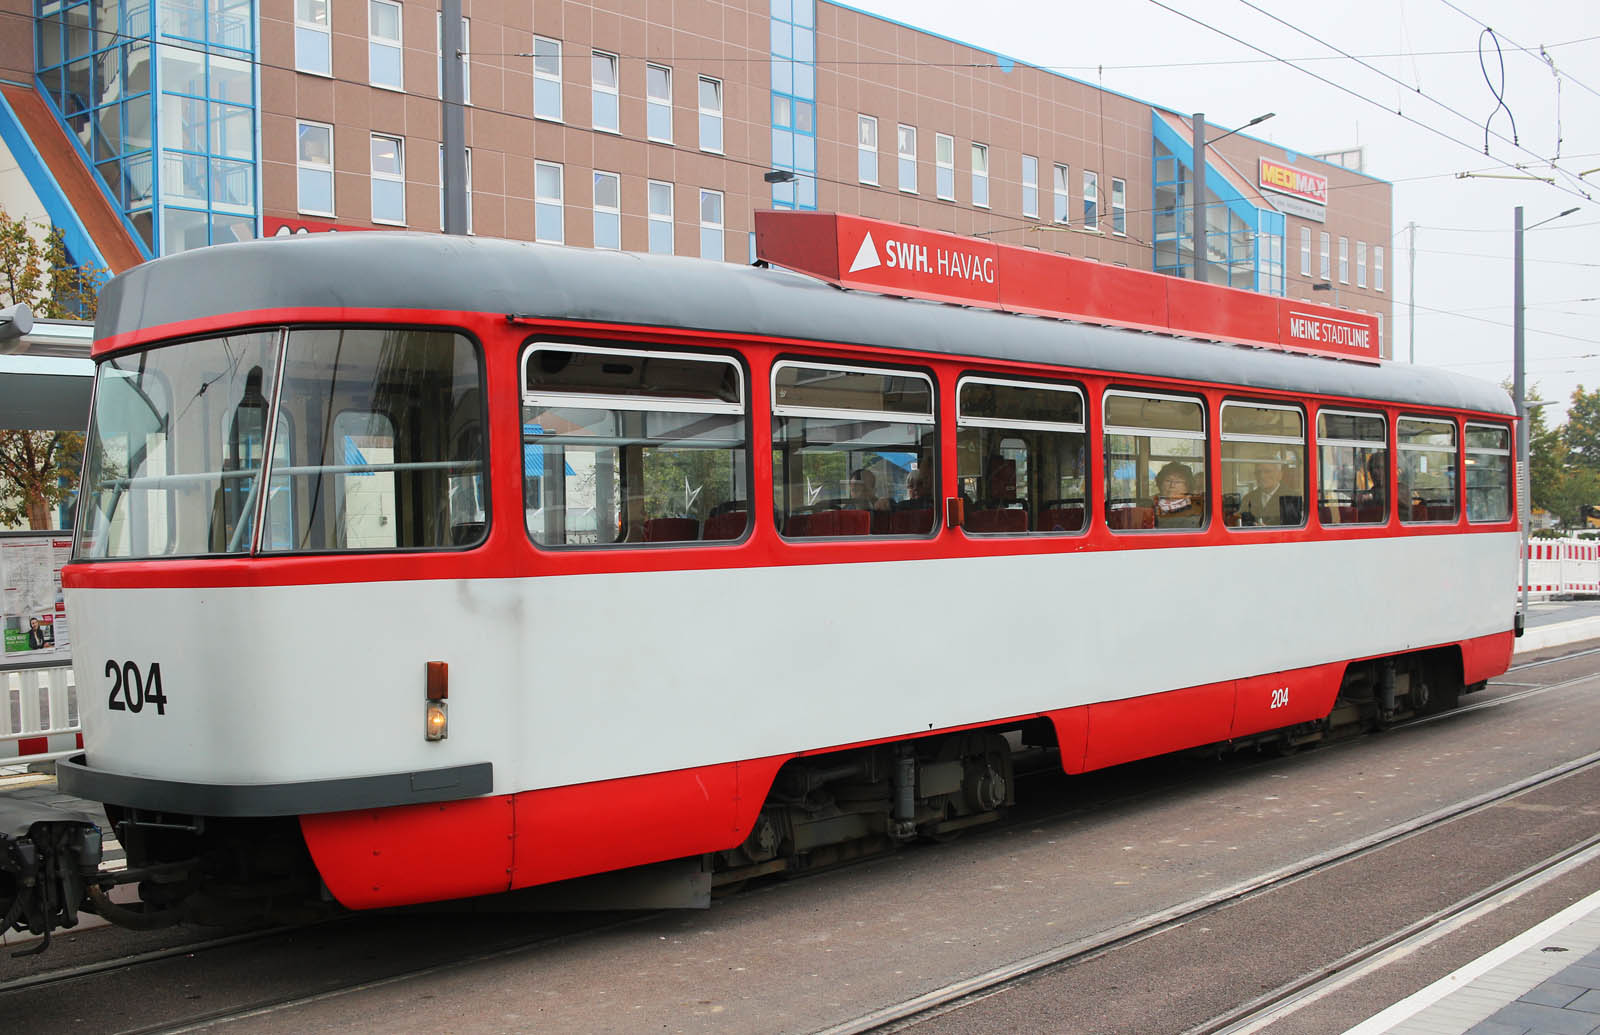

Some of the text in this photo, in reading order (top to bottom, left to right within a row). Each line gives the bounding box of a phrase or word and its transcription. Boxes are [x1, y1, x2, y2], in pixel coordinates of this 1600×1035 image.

[1263, 163, 1326, 199] MEDIMAX
[886, 239, 994, 283] SWH. HAVAG
[1290, 317, 1370, 348] MEINE STADTLINIE
[105, 659, 168, 715] 204
[1270, 687, 1289, 709] 204
